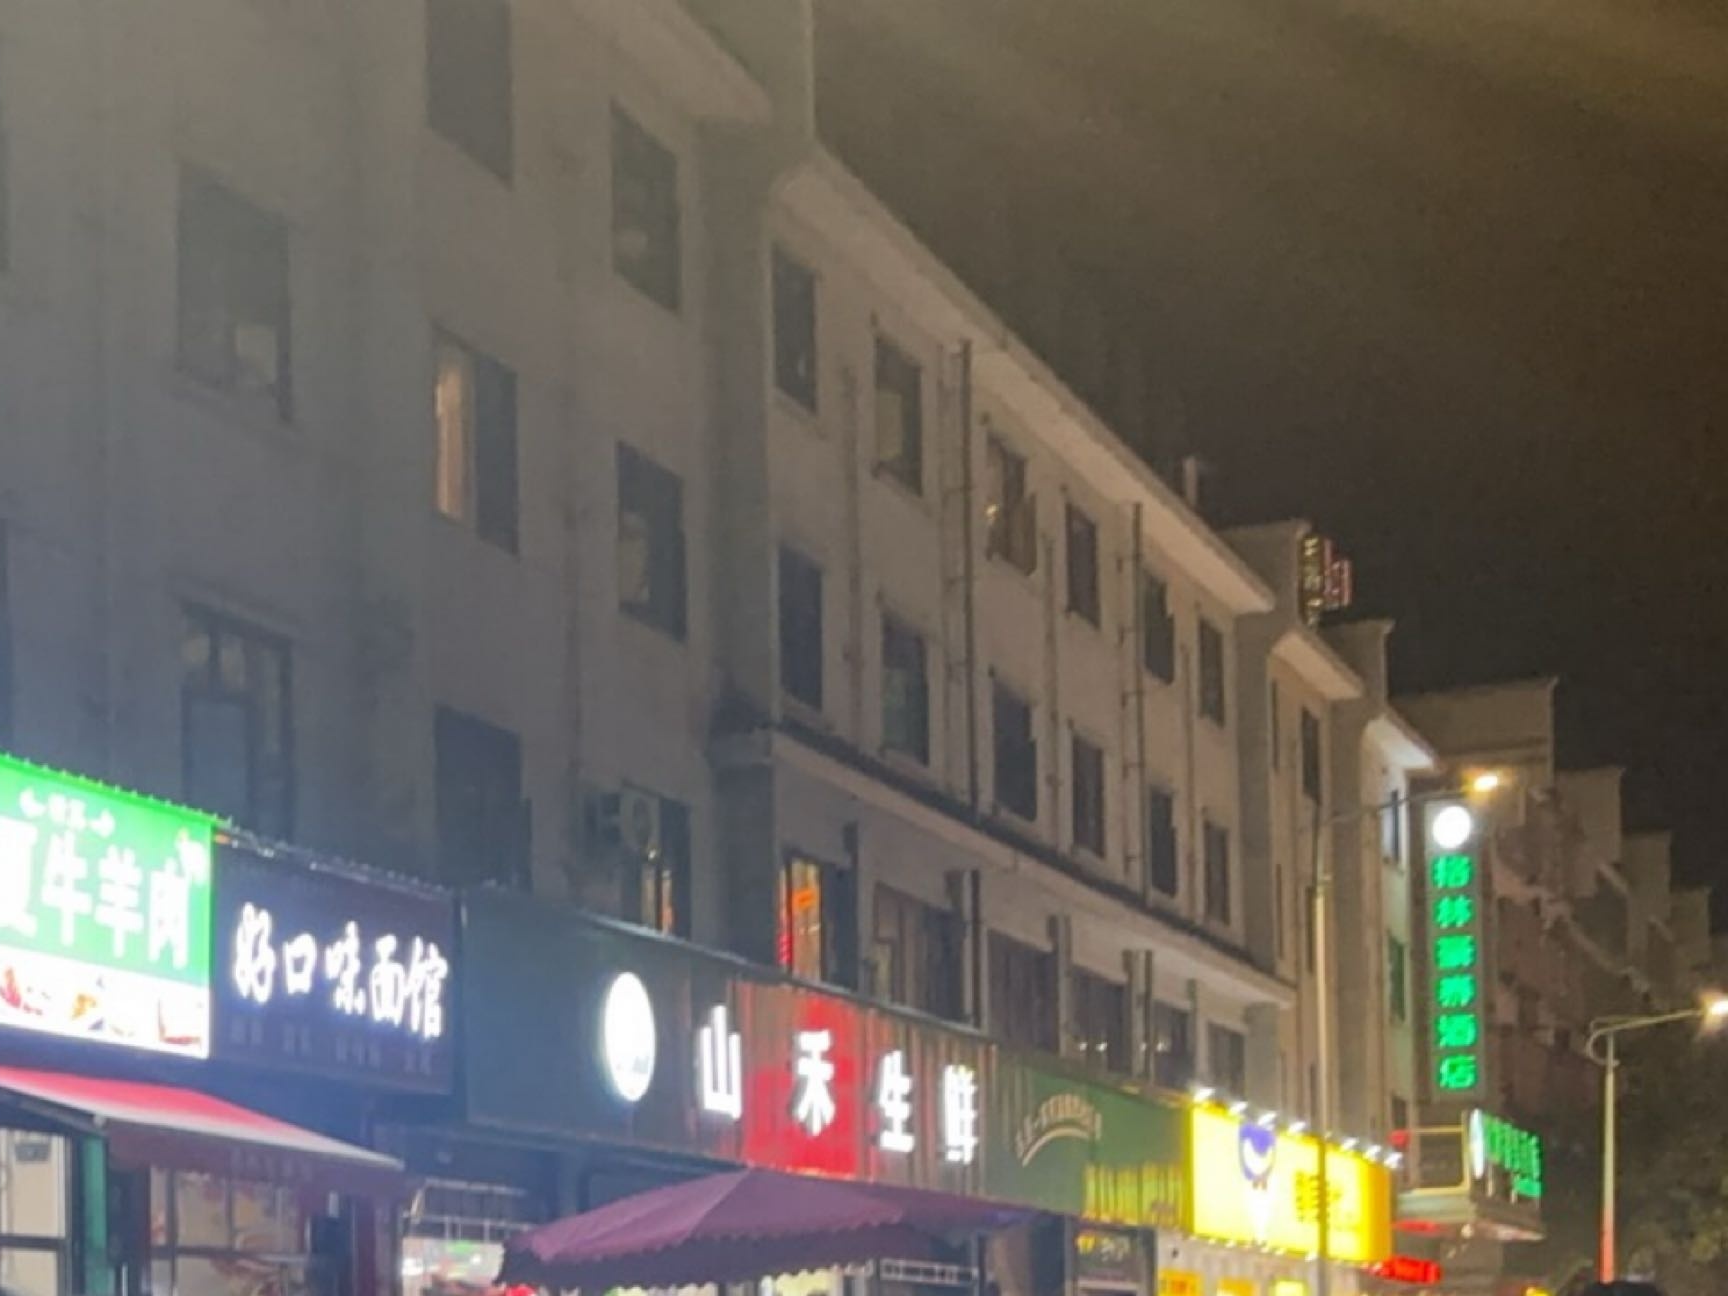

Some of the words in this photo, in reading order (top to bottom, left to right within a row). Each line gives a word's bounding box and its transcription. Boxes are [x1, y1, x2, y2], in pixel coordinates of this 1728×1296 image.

[232, 901, 449, 1039] 好口味面馆
[698, 1003, 978, 1166] 山禾生鲜
